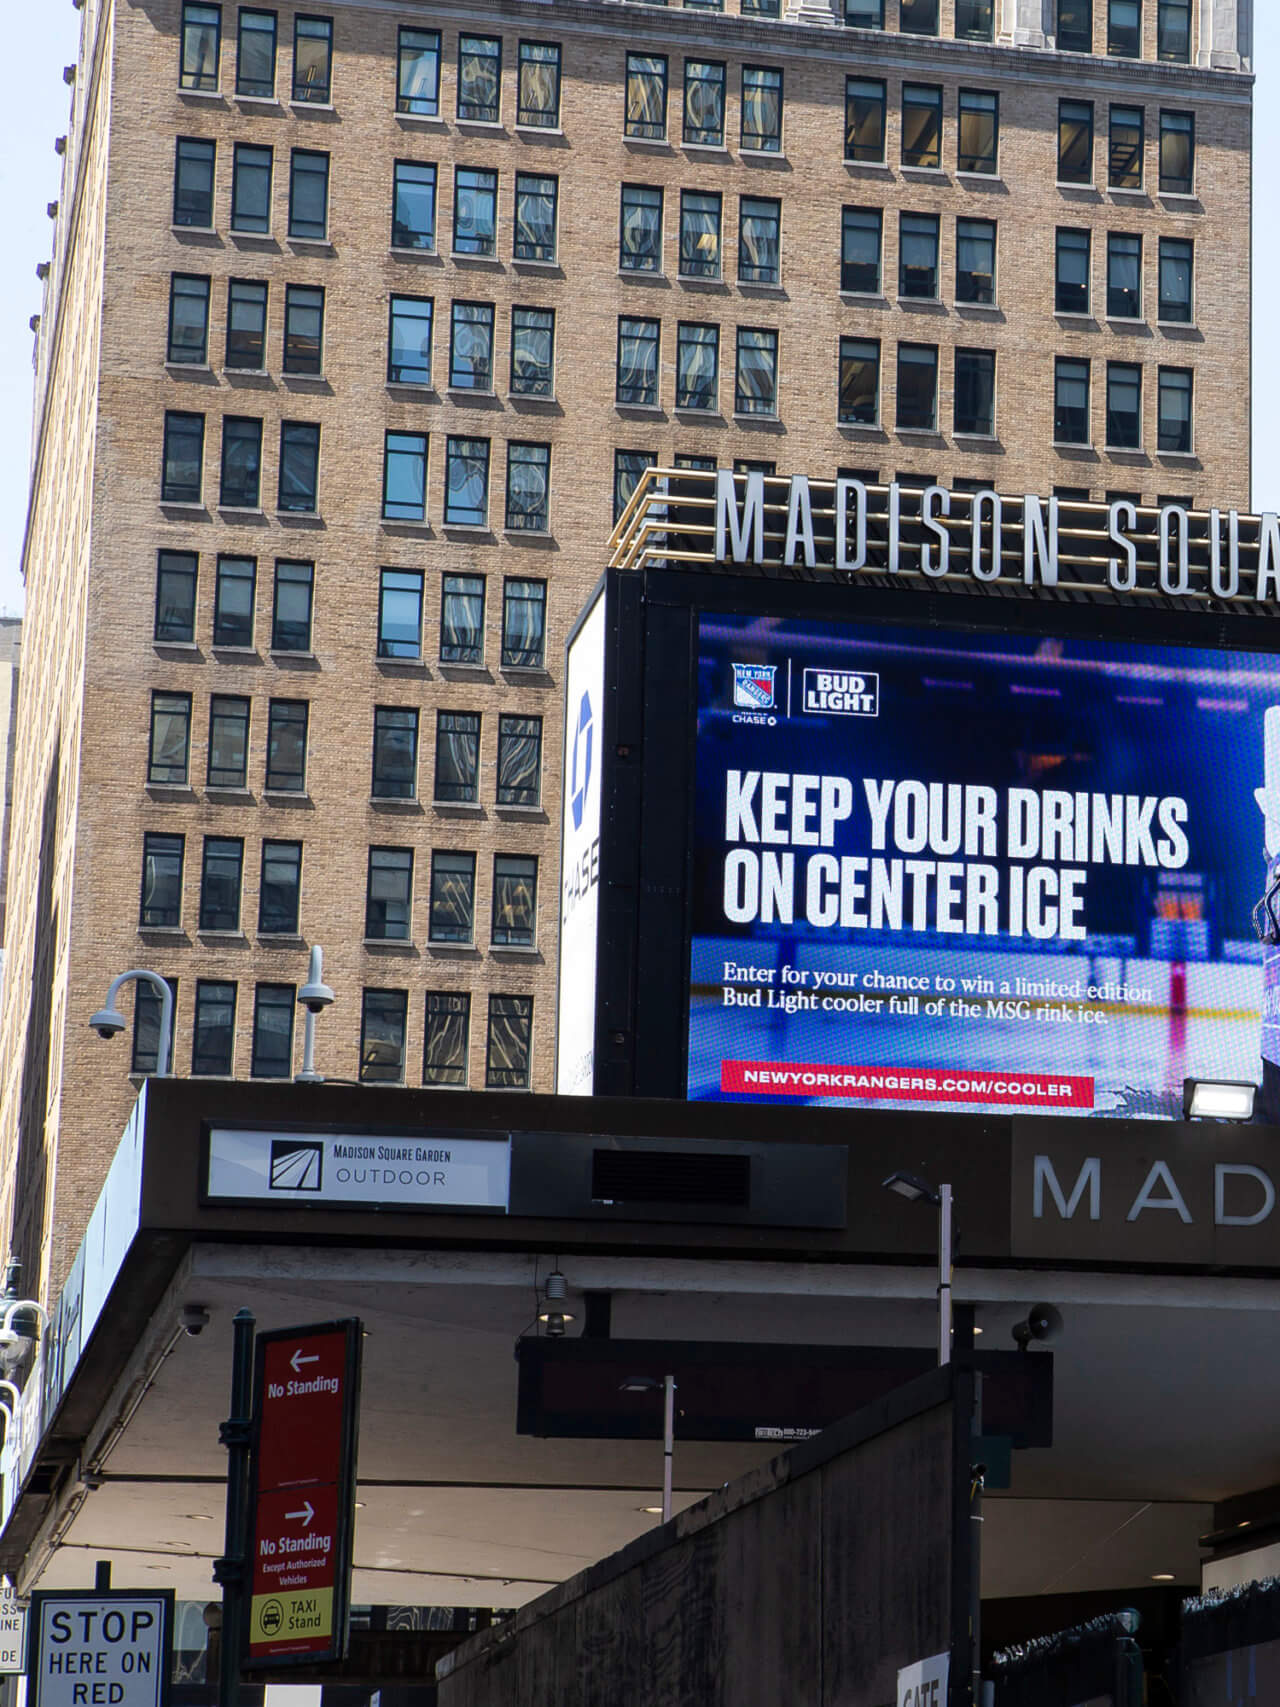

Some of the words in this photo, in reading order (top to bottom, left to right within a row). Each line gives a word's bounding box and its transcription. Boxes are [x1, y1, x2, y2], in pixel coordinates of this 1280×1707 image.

[715, 469, 1058, 587] MADISON
[817, 674, 865, 693] BUD
[808, 690, 874, 712] LIGHT
[732, 714, 767, 725] CHASE
[726, 770, 852, 847] KEEP
[863, 778, 998, 856] YOUR
[1007, 787, 1189, 869] DRINKS
[724, 849, 795, 925] ON
[806, 854, 999, 936] CENTER
[1010, 866, 1087, 940] ICE
[723, 962, 776, 983] Enter
[782, 965, 809, 985] for
[813, 970, 858, 990] your
[862, 970, 930, 990] chance
[935, 975, 955, 992] to
[961, 975, 994, 994] win
[1000, 981, 1011, 995] a
[1016, 977, 1153, 1001] limited-edition
[722, 987, 761, 1007] Bud
[767, 989, 819, 1013] Light
[822, 994, 883, 1014] cooler
[889, 996, 919, 1015] full
[925, 998, 946, 1016] of
[950, 999, 982, 1018] the
[986, 1000, 1031, 1020] MSG
[1036, 1003, 1074, 1023] rink
[1078, 1006, 1108, 1024] ice.
[744, 1070, 1073, 1098] NEWYORKRANGERS.COM/COOLER
[334, 1144, 375, 1160] MADISON
[378, 1145, 413, 1161] SQUARE
[415, 1147, 451, 1163] GARDEN
[336, 1168, 446, 1186] OUTDOOR
[268, 1383, 284, 1398] No
[287, 1376, 339, 1394] Standing
[260, 1539, 276, 1556] No
[279, 1532, 331, 1553] Standing
[263, 1562, 286, 1573] Except
[287, 1557, 326, 1570] Authorized
[280, 1574, 307, 1585] Vehicles
[0, 1603, 17, 1615] SS
[291, 1599, 316, 1614] TAXI
[50, 1611, 154, 1643] STOP
[288, 1612, 321, 1630] Stand
[50, 1652, 108, 1674] HERE
[121, 1651, 150, 1674] ON
[73, 1683, 124, 1705] RED
